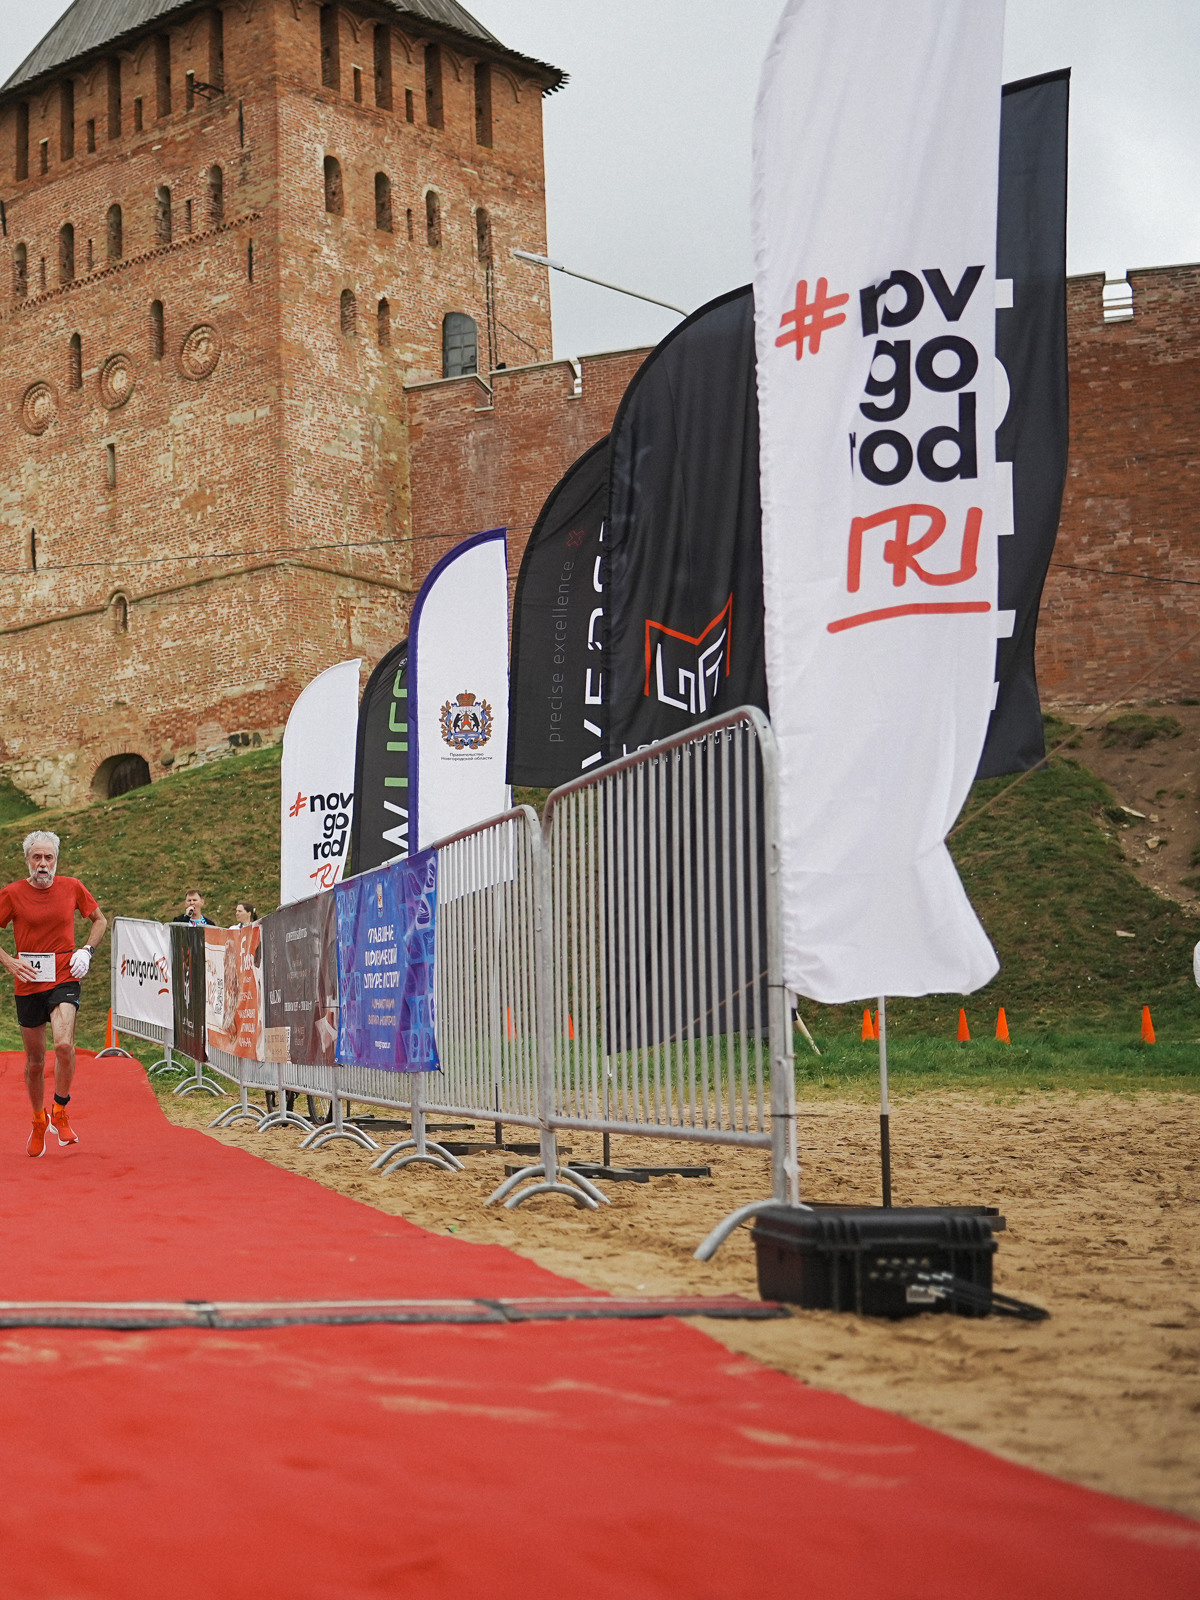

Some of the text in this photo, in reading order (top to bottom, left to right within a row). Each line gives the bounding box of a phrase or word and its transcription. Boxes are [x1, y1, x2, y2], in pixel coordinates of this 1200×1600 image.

[859, 335, 979, 422] go
[548, 560, 575, 744] precise excellence
[313, 830, 347, 861] rod
[323, 812, 350, 839] go
